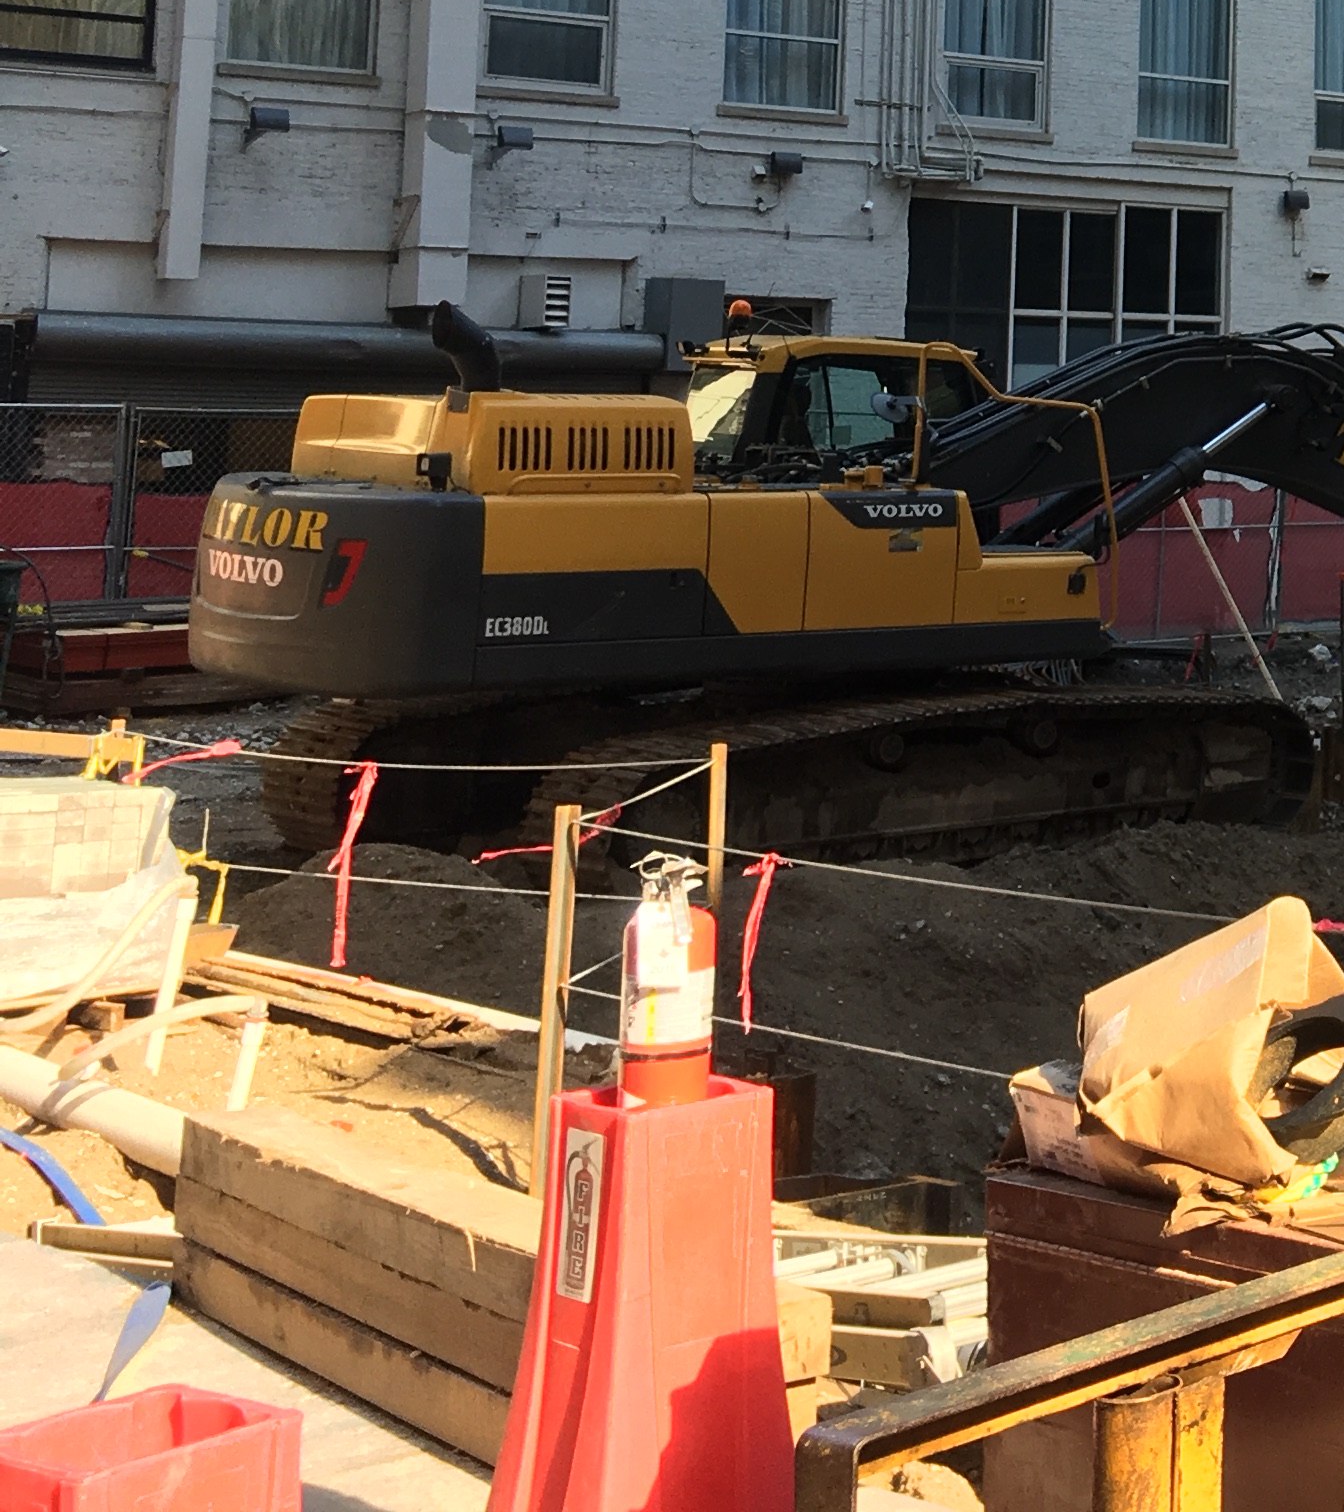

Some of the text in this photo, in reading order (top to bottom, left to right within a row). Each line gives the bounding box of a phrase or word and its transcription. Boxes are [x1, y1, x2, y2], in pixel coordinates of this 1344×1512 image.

[864, 503, 943, 518] VOLVO
[208, 548, 284, 587] VOLVO
[569, 1180, 590, 1279] FIRE
